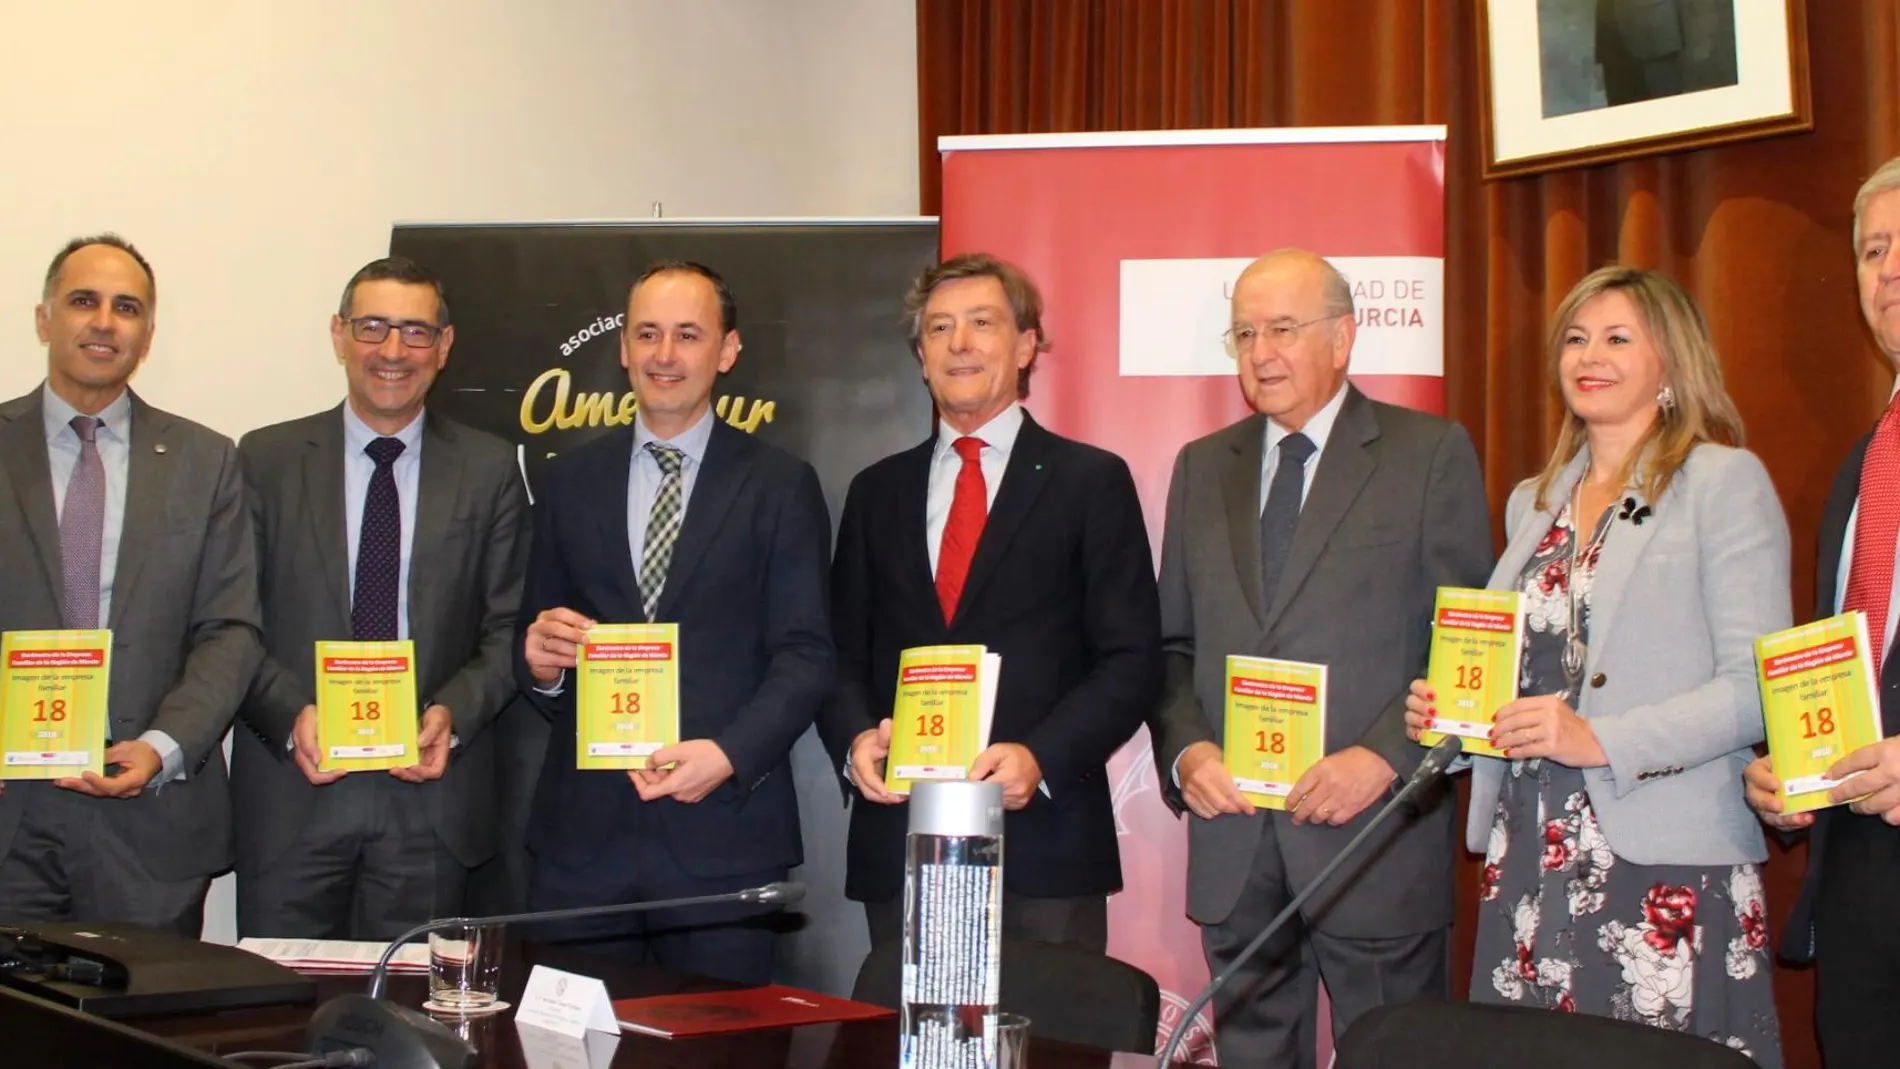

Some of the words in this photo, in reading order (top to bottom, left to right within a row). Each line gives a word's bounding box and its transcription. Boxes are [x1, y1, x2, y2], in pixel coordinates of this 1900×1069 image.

[1394, 280, 1425, 300] DE
[1355, 308, 1424, 328] URCIA
[559, 313, 625, 356] asociac
[1454, 664, 1483, 690] 18
[32, 699, 66, 722] 18
[350, 700, 380, 721] 18
[610, 692, 640, 714] 18
[916, 714, 944, 736] 18
[1800, 707, 1835, 739] 18
[1255, 730, 1285, 754] 18
